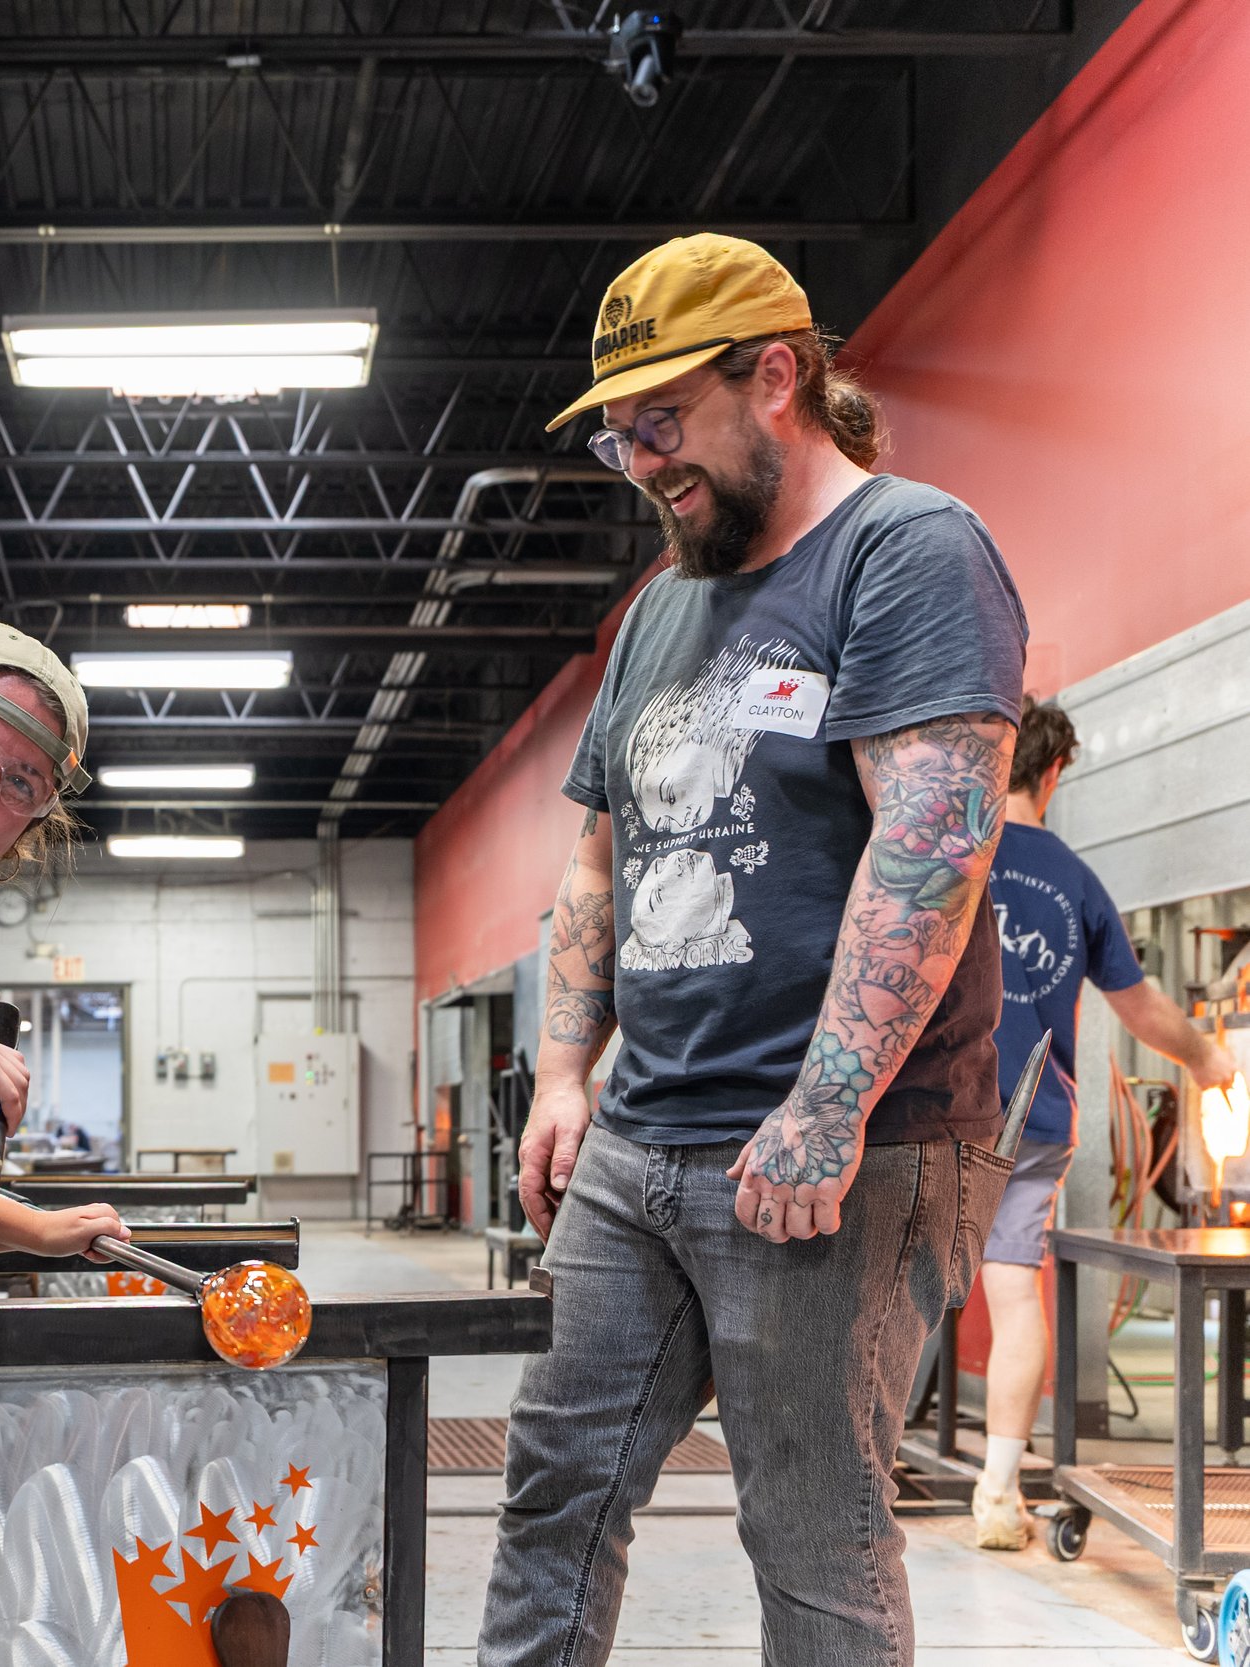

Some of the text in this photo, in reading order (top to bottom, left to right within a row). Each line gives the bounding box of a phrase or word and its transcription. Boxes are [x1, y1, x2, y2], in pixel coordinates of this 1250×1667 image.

[763, 694, 792, 702] FIREFEST
[748, 704, 804, 721] CLAYTON
[633, 822, 756, 854] WE SUPPORT UKRAINE
[619, 935, 754, 972] STARWORKS
[53, 956, 83, 982] EXIT
